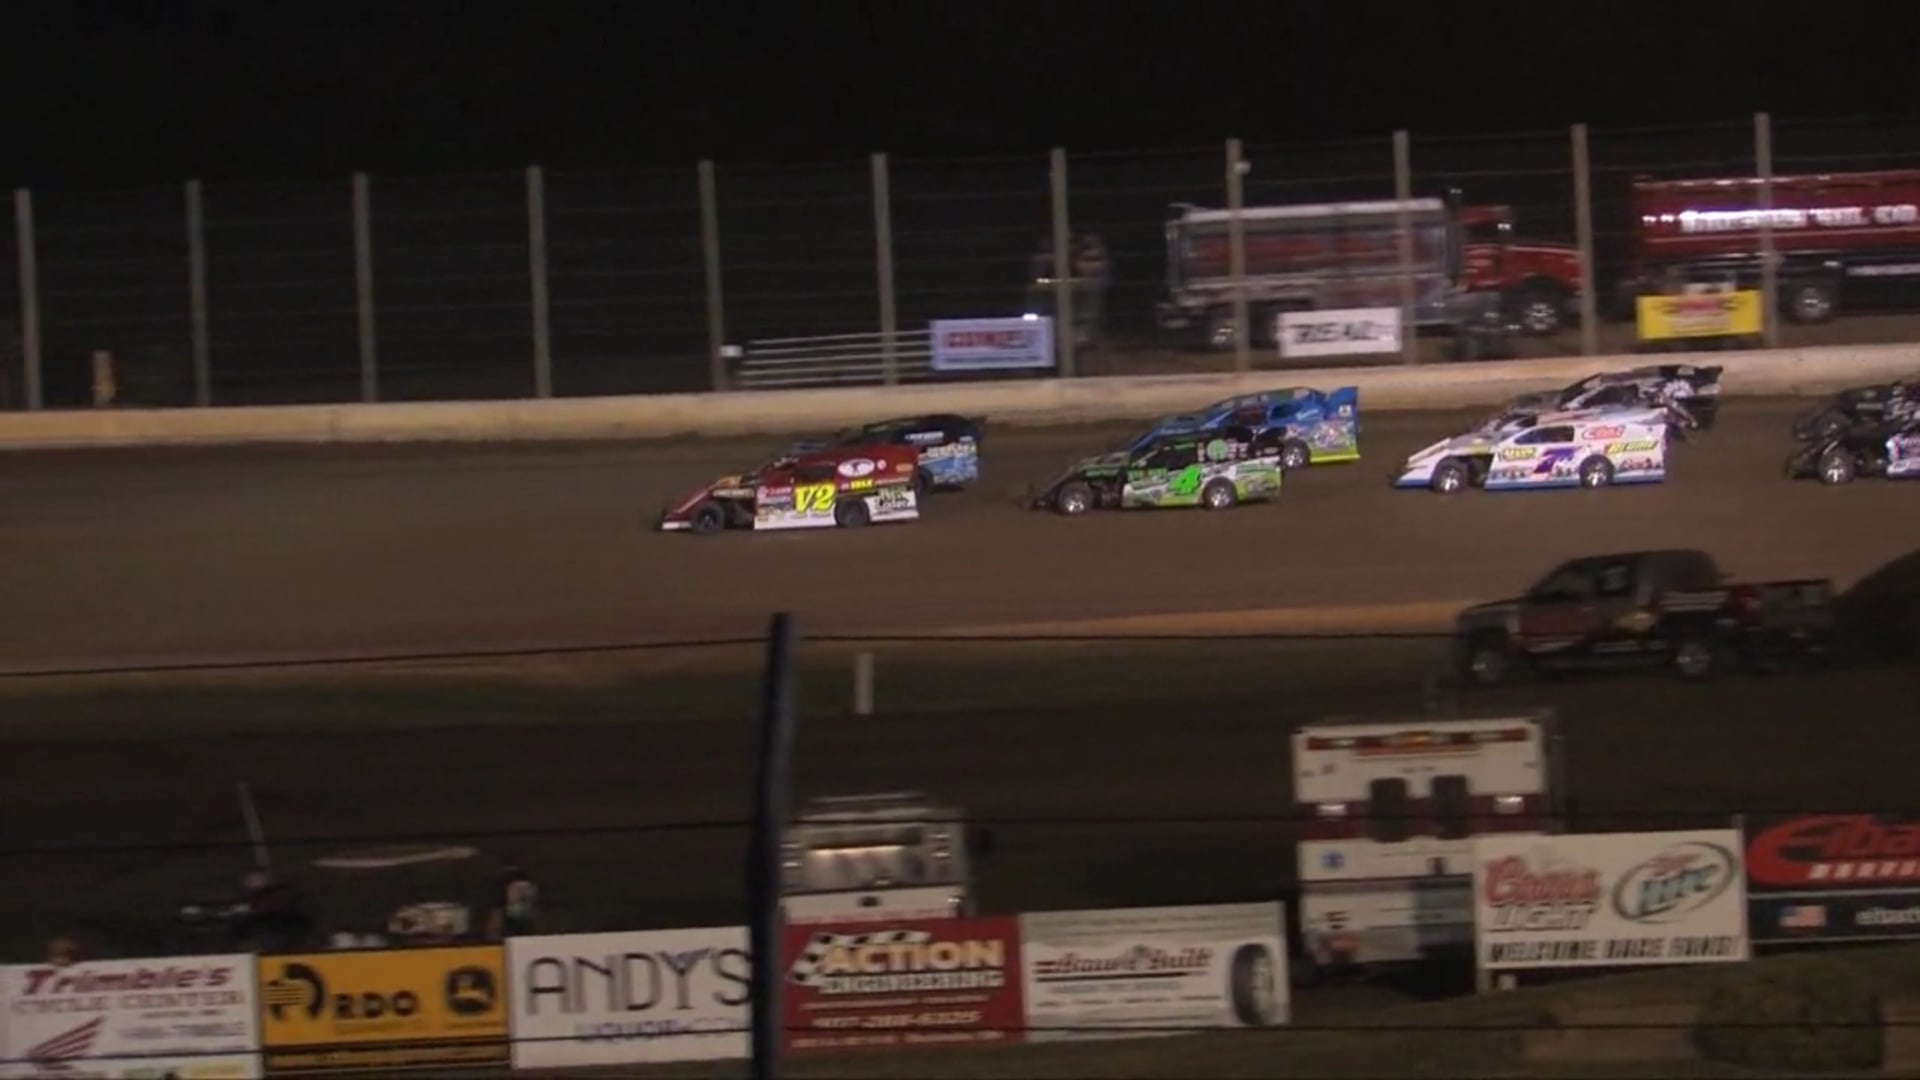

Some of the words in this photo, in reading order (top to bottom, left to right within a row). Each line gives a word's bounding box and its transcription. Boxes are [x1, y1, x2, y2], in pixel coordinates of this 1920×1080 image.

[1167, 463, 1203, 496] 4
[793, 482, 836, 513] V2
[822, 941, 1004, 975] ACTION
[23, 965, 234, 996] Trimble's
[332, 989, 419, 1019] RDO
